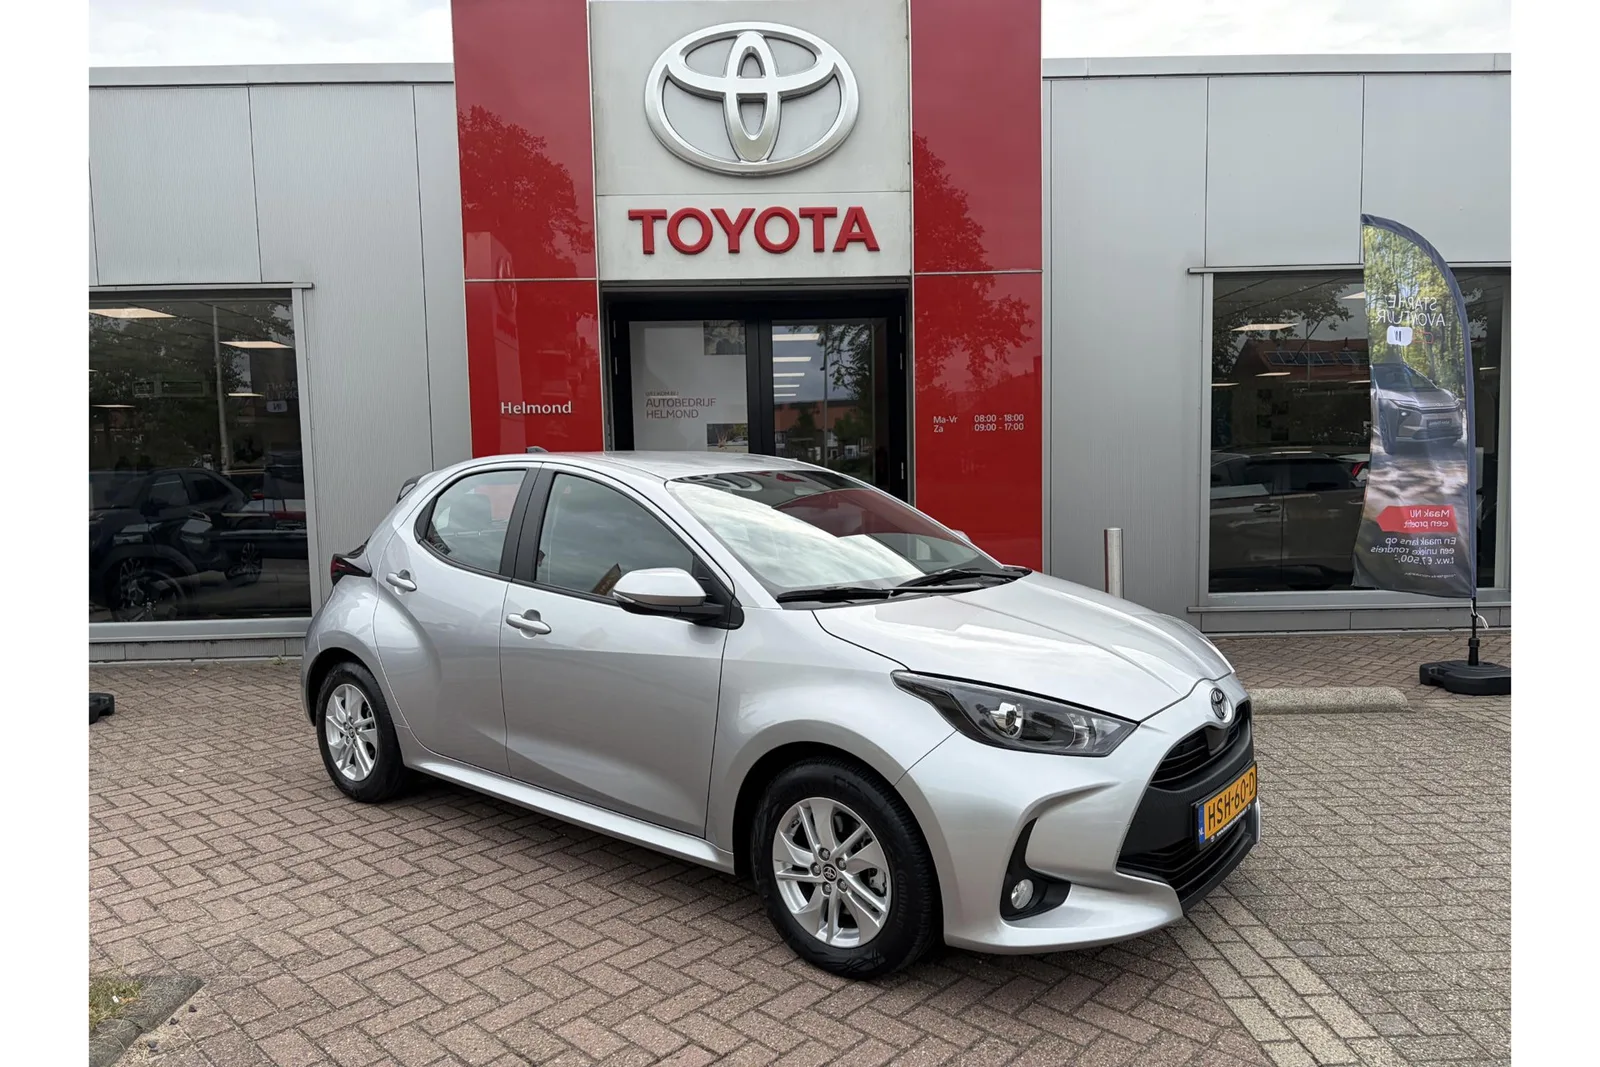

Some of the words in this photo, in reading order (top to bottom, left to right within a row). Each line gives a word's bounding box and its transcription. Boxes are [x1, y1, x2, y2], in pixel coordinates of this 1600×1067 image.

[628, 206, 880, 255] TOYOTA
[500, 400, 572, 414] Helmond
[645, 398, 716, 408] AUTOBEDRIJF
[646, 409, 699, 419] HELMOND
[933, 415, 959, 424] Ma-Vr
[974, 414, 997, 423] 08:00
[1004, 413, 1025, 422] 18:00
[933, 425, 944, 433] Za
[974, 423, 997, 432] 09:00
[1004, 422, 1025, 431] 17:00
[1207, 770, 1255, 831] HSH-60-D
